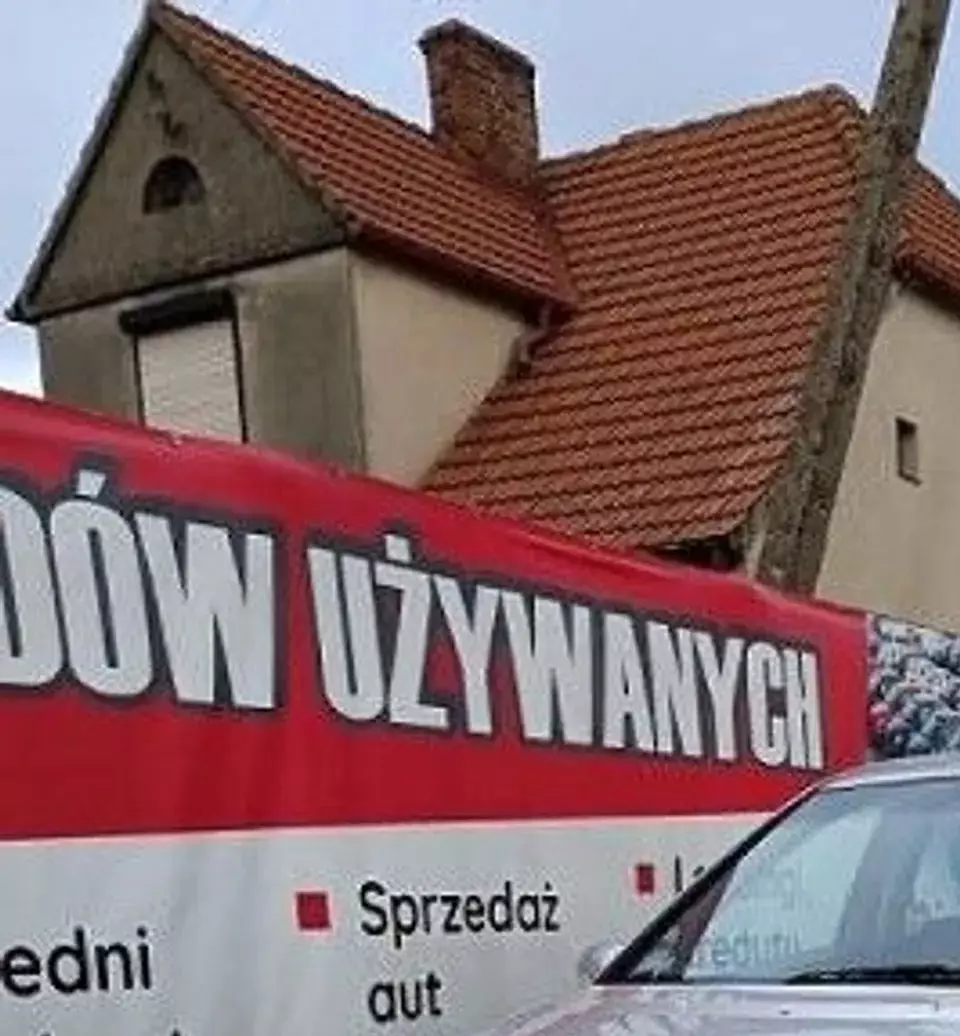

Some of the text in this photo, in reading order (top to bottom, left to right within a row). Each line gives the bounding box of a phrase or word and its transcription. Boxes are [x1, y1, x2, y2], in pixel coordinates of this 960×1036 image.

[307, 536, 825, 770] UŻYWANYCH
[359, 880, 561, 949] Sprzedaż
[368, 971, 442, 1023] aut
